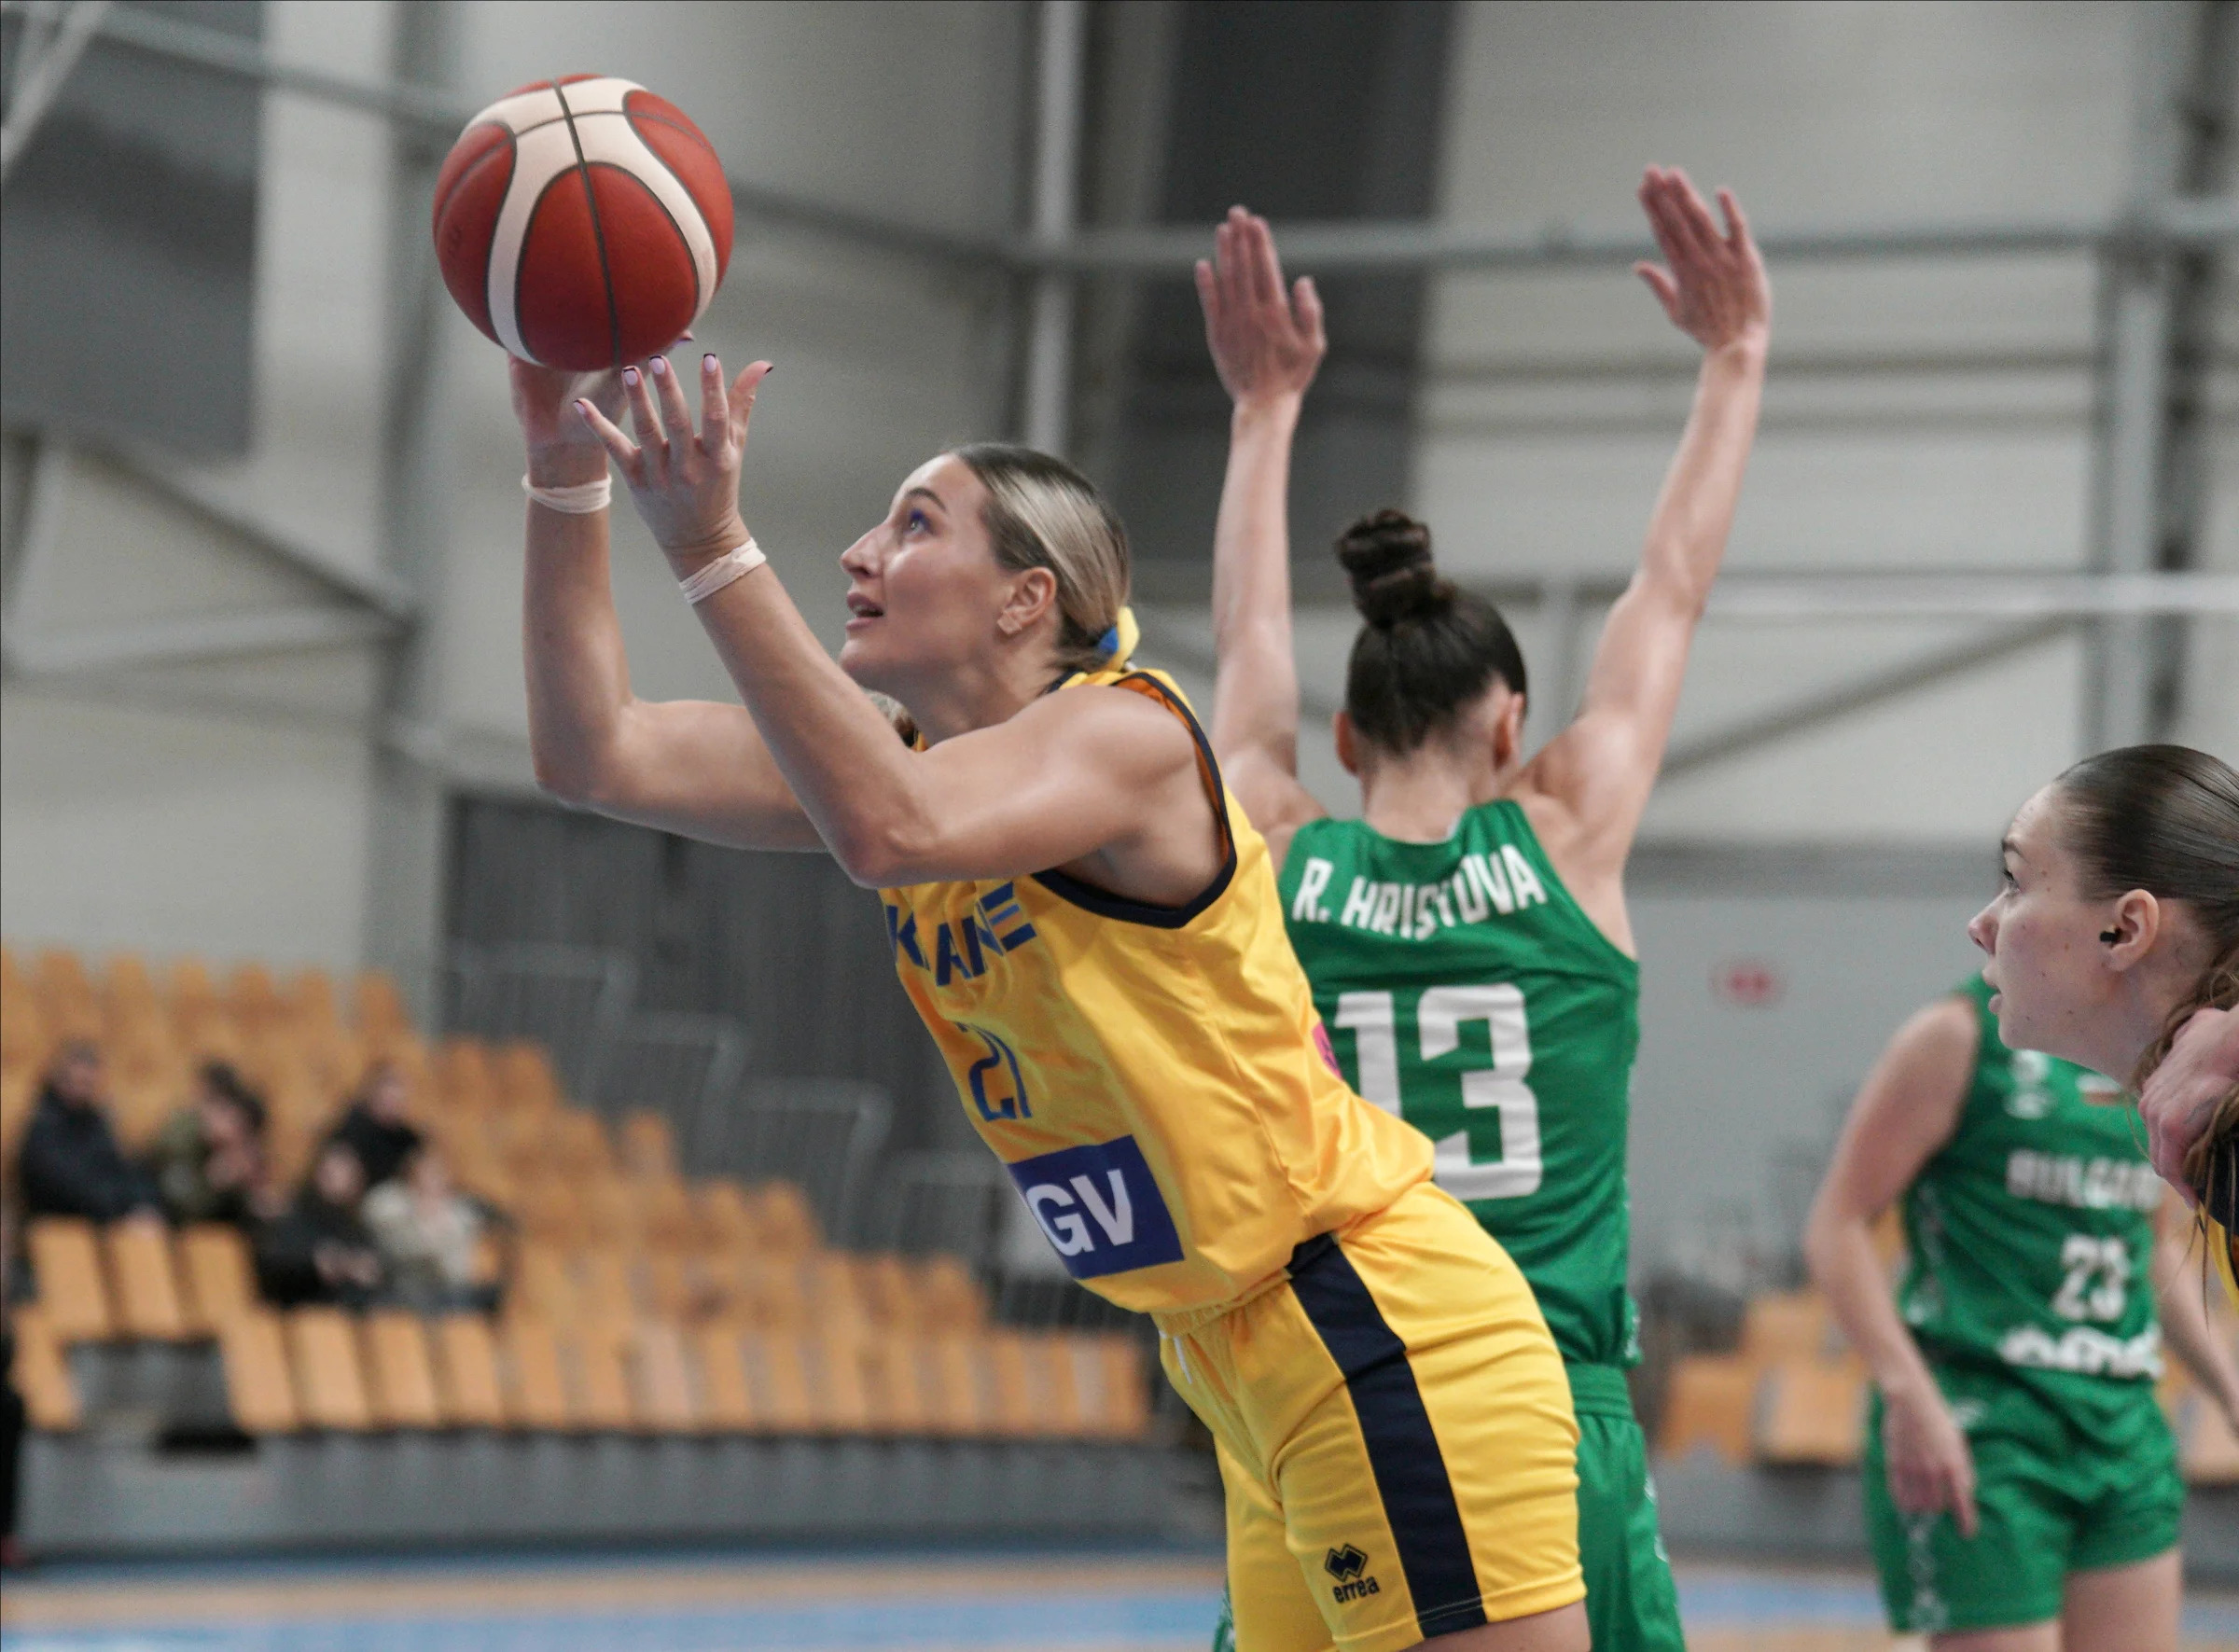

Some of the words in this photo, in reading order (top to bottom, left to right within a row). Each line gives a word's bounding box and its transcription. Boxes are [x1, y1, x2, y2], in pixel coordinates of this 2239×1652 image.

[1291, 856, 1334, 923] R.
[1339, 842, 1549, 942] HRISTOVA
[1334, 982, 1543, 1201] 13
[2052, 1233, 2129, 1323] 23
[1332, 1576, 1381, 1603] errea
